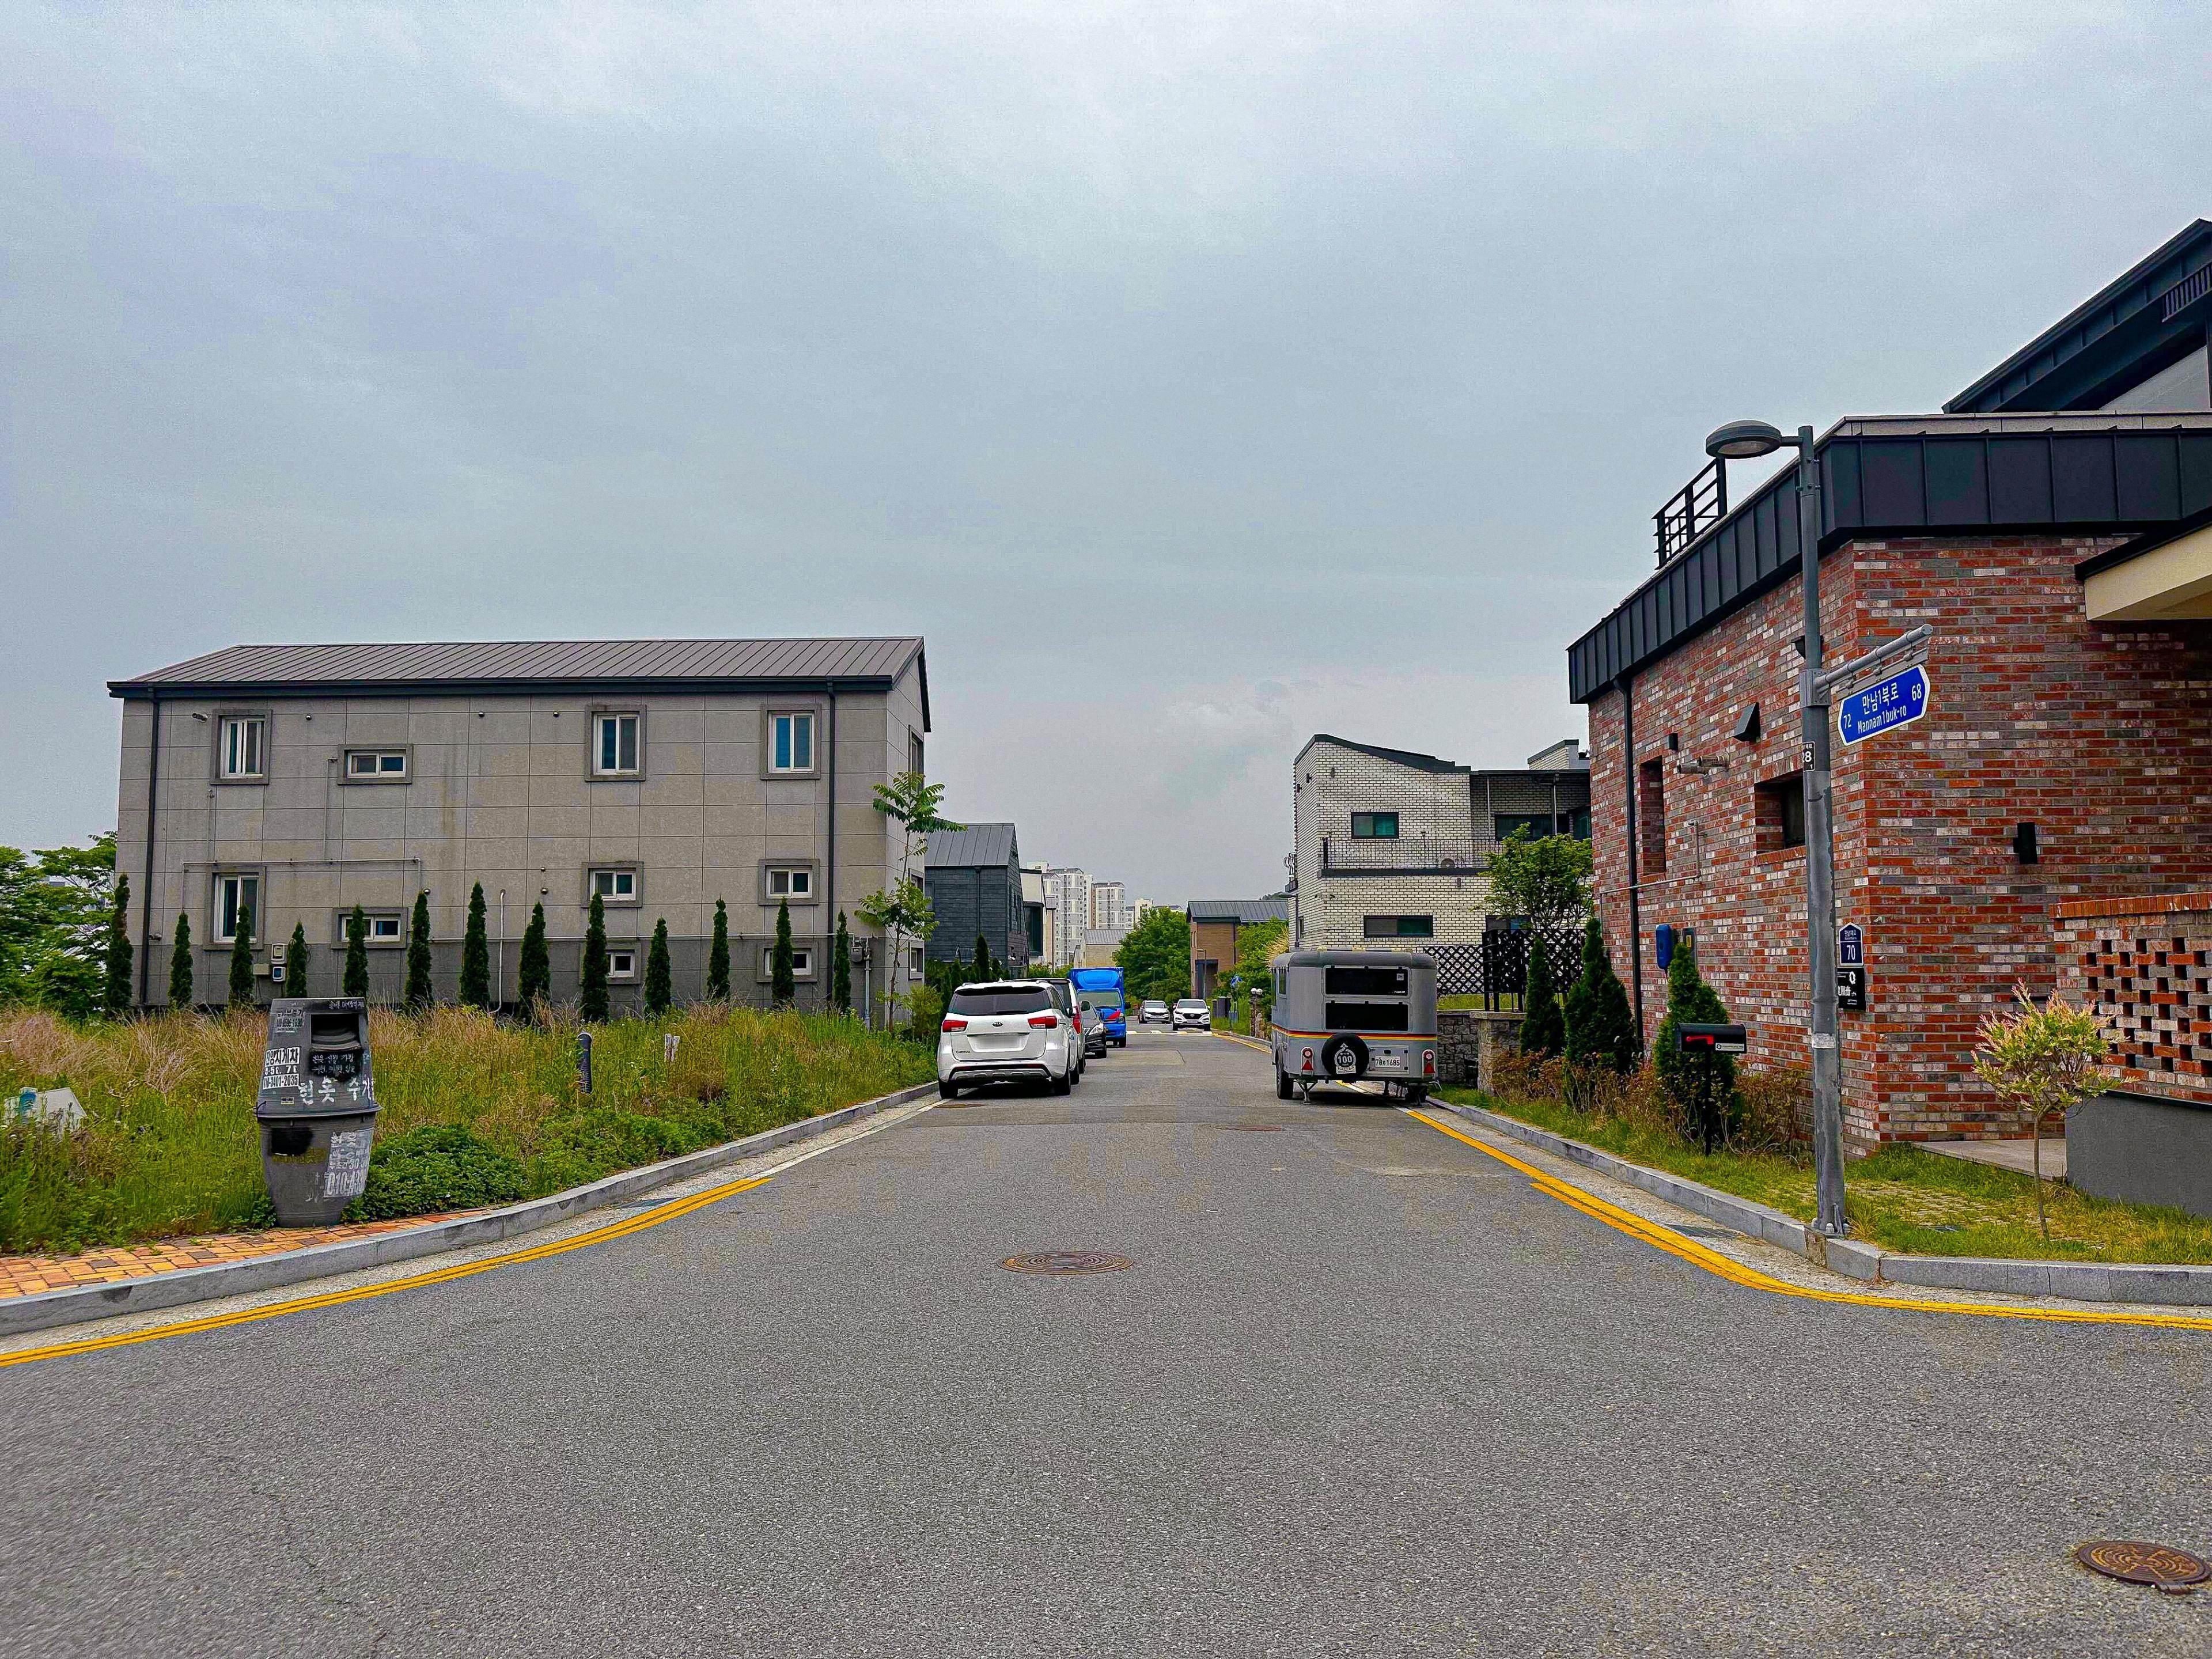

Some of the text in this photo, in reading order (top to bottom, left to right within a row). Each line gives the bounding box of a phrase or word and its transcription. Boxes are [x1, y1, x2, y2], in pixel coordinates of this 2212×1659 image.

[1862, 682, 1899, 715] 만남1북로
[1911, 683, 1922, 701] 68
[1843, 714, 1852, 729] 72
[1846, 945, 1855, 960] 70
[1337, 1055, 1353, 1063] 100
